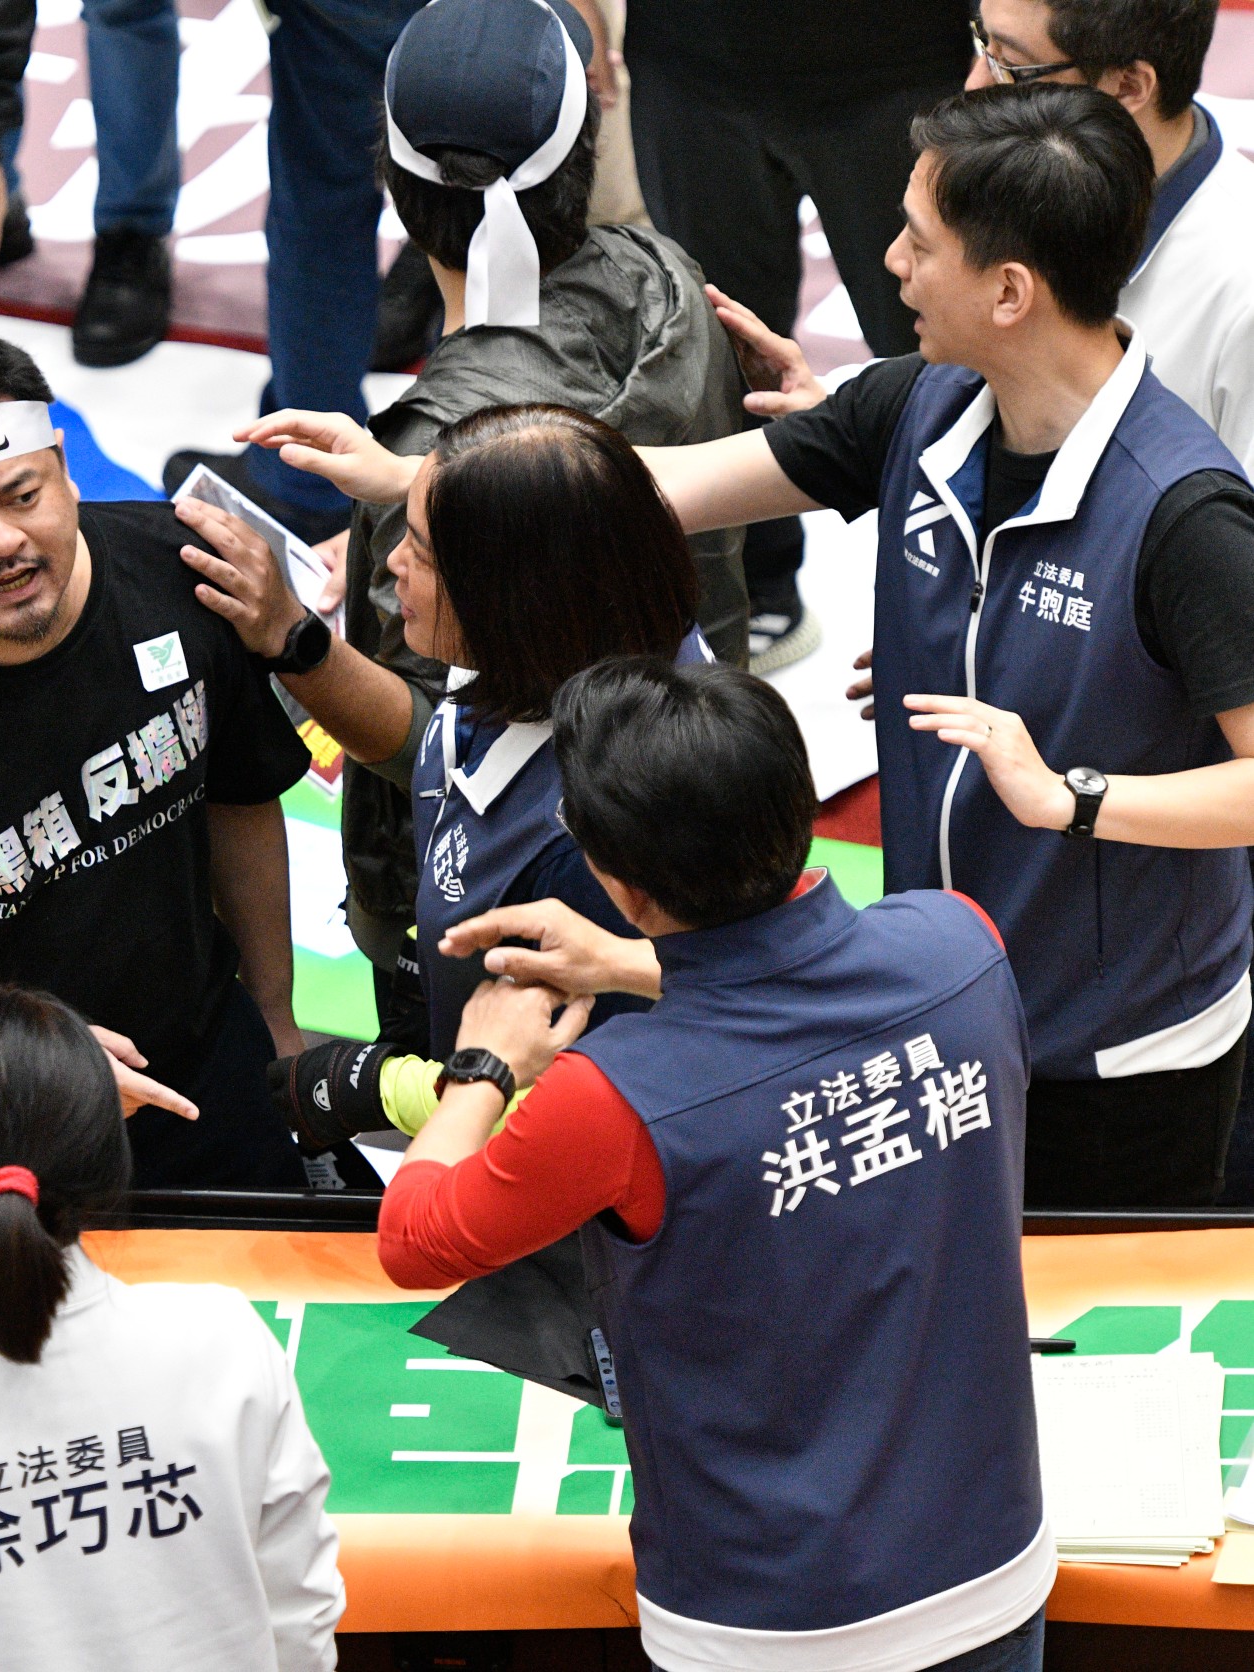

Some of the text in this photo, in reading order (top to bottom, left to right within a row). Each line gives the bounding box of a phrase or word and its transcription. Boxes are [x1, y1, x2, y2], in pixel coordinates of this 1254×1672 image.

[1018, 581, 1094, 632] 牛煦庭
[1034, 559, 1085, 591] 立法委員
[70, 845, 109, 874] FOR
[112, 782, 206, 857] DEMOCRAC
[780, 1032, 945, 1134] 立法委員
[760, 1060, 993, 1217] 洪孟楷
